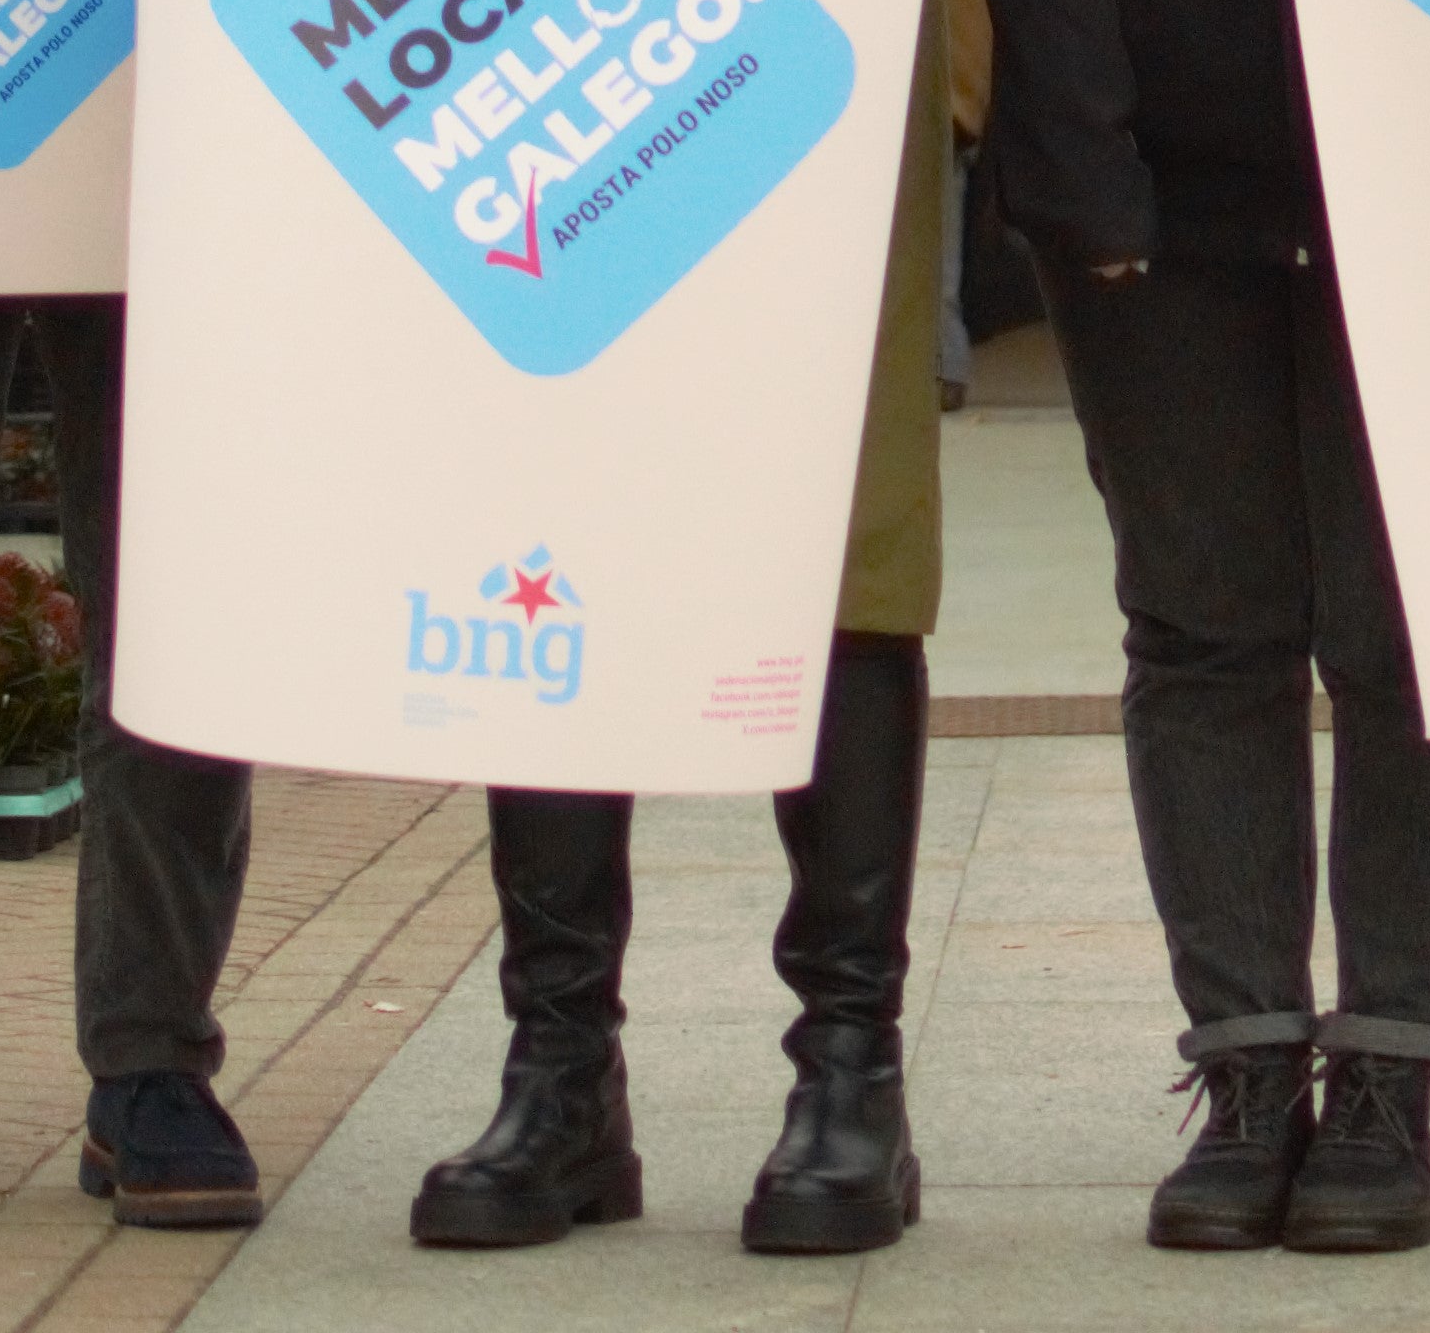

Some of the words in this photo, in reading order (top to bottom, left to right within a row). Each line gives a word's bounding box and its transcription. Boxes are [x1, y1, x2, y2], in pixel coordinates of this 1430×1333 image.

[0, 55, 45, 103] APOSTA
[41, 25, 74, 59] POLO
[552, 165, 642, 250] APOSTA
[636, 109, 699, 171] POLO
[695, 53, 760, 117] NOSO
[404, 589, 585, 705] bng
